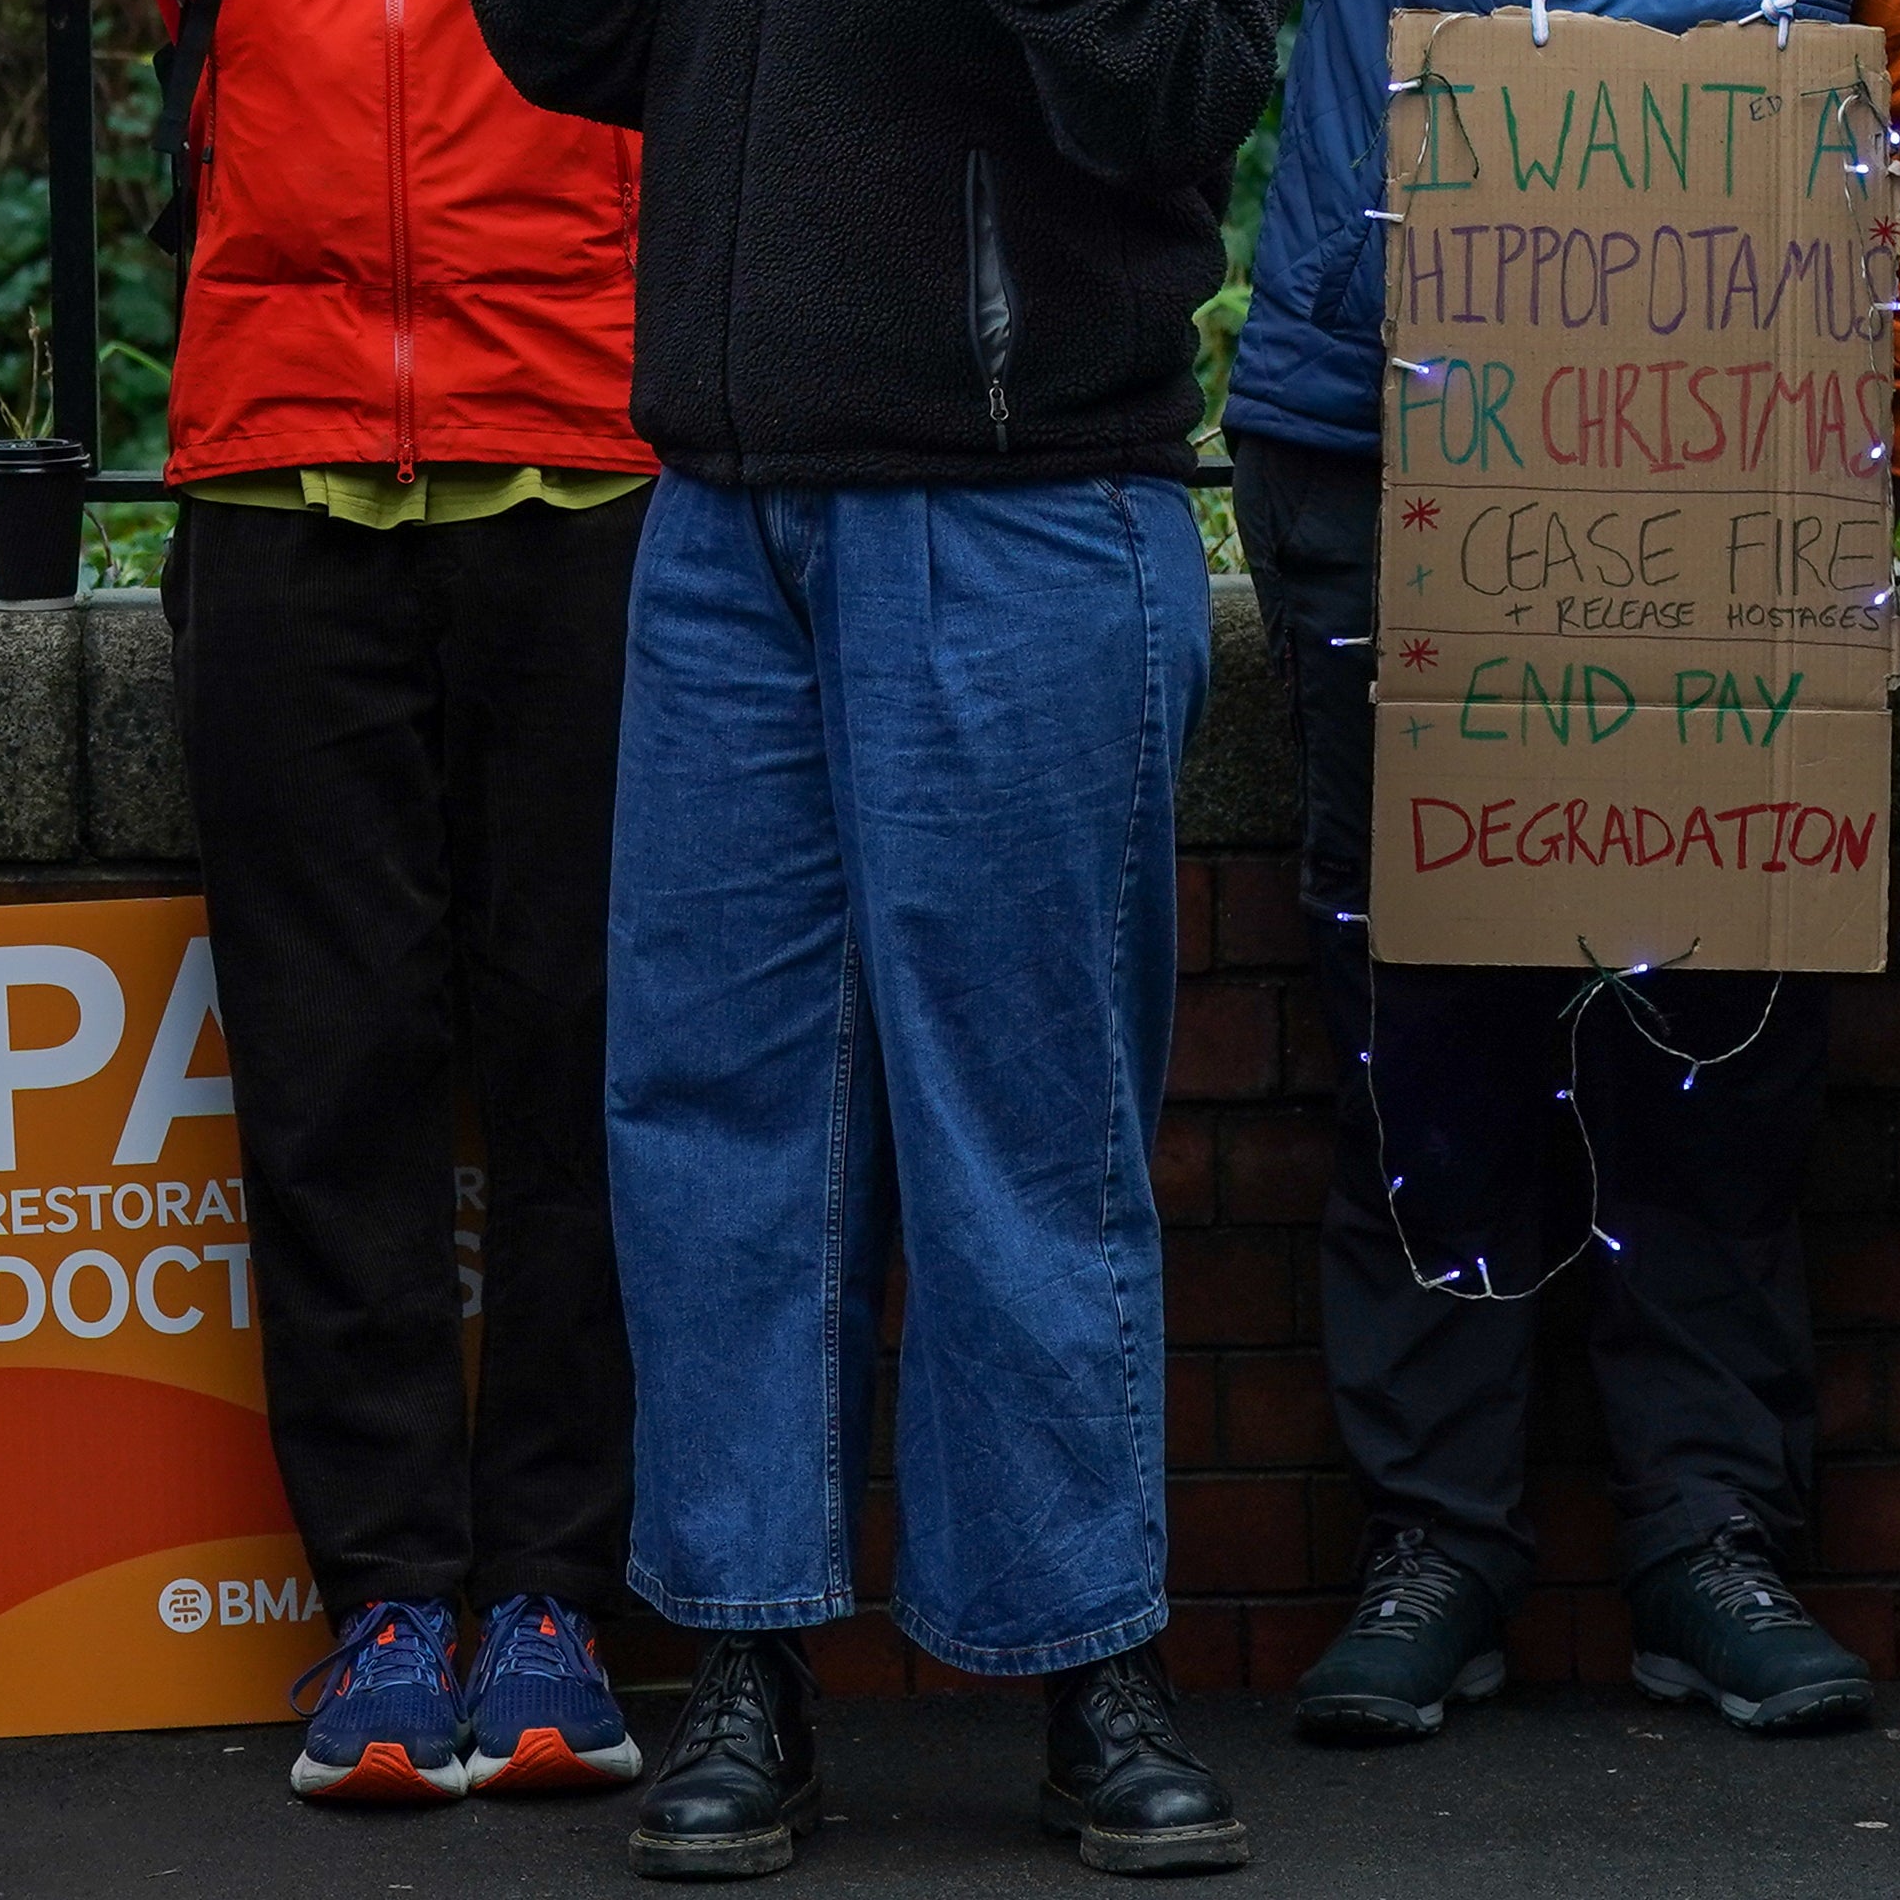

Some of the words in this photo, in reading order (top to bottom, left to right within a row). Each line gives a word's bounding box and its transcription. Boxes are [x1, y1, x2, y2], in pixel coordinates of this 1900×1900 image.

[1402, 82, 1477, 191] I
[1801, 81, 1871, 202] A
[1399, 356, 1525, 475] FOR
[1540, 362, 1893, 480] CHRISTMAS
[1460, 503, 1682, 596] CEASE
[1726, 510, 1880, 596] FIRE
[1557, 595, 1695, 635] RELEASE
[1727, 603, 1881, 631] HOSTAGES
[1459, 656, 1637, 747] END
[1674, 669, 1805, 748] PAY
[1410, 797, 1877, 874] DEGRADATION
